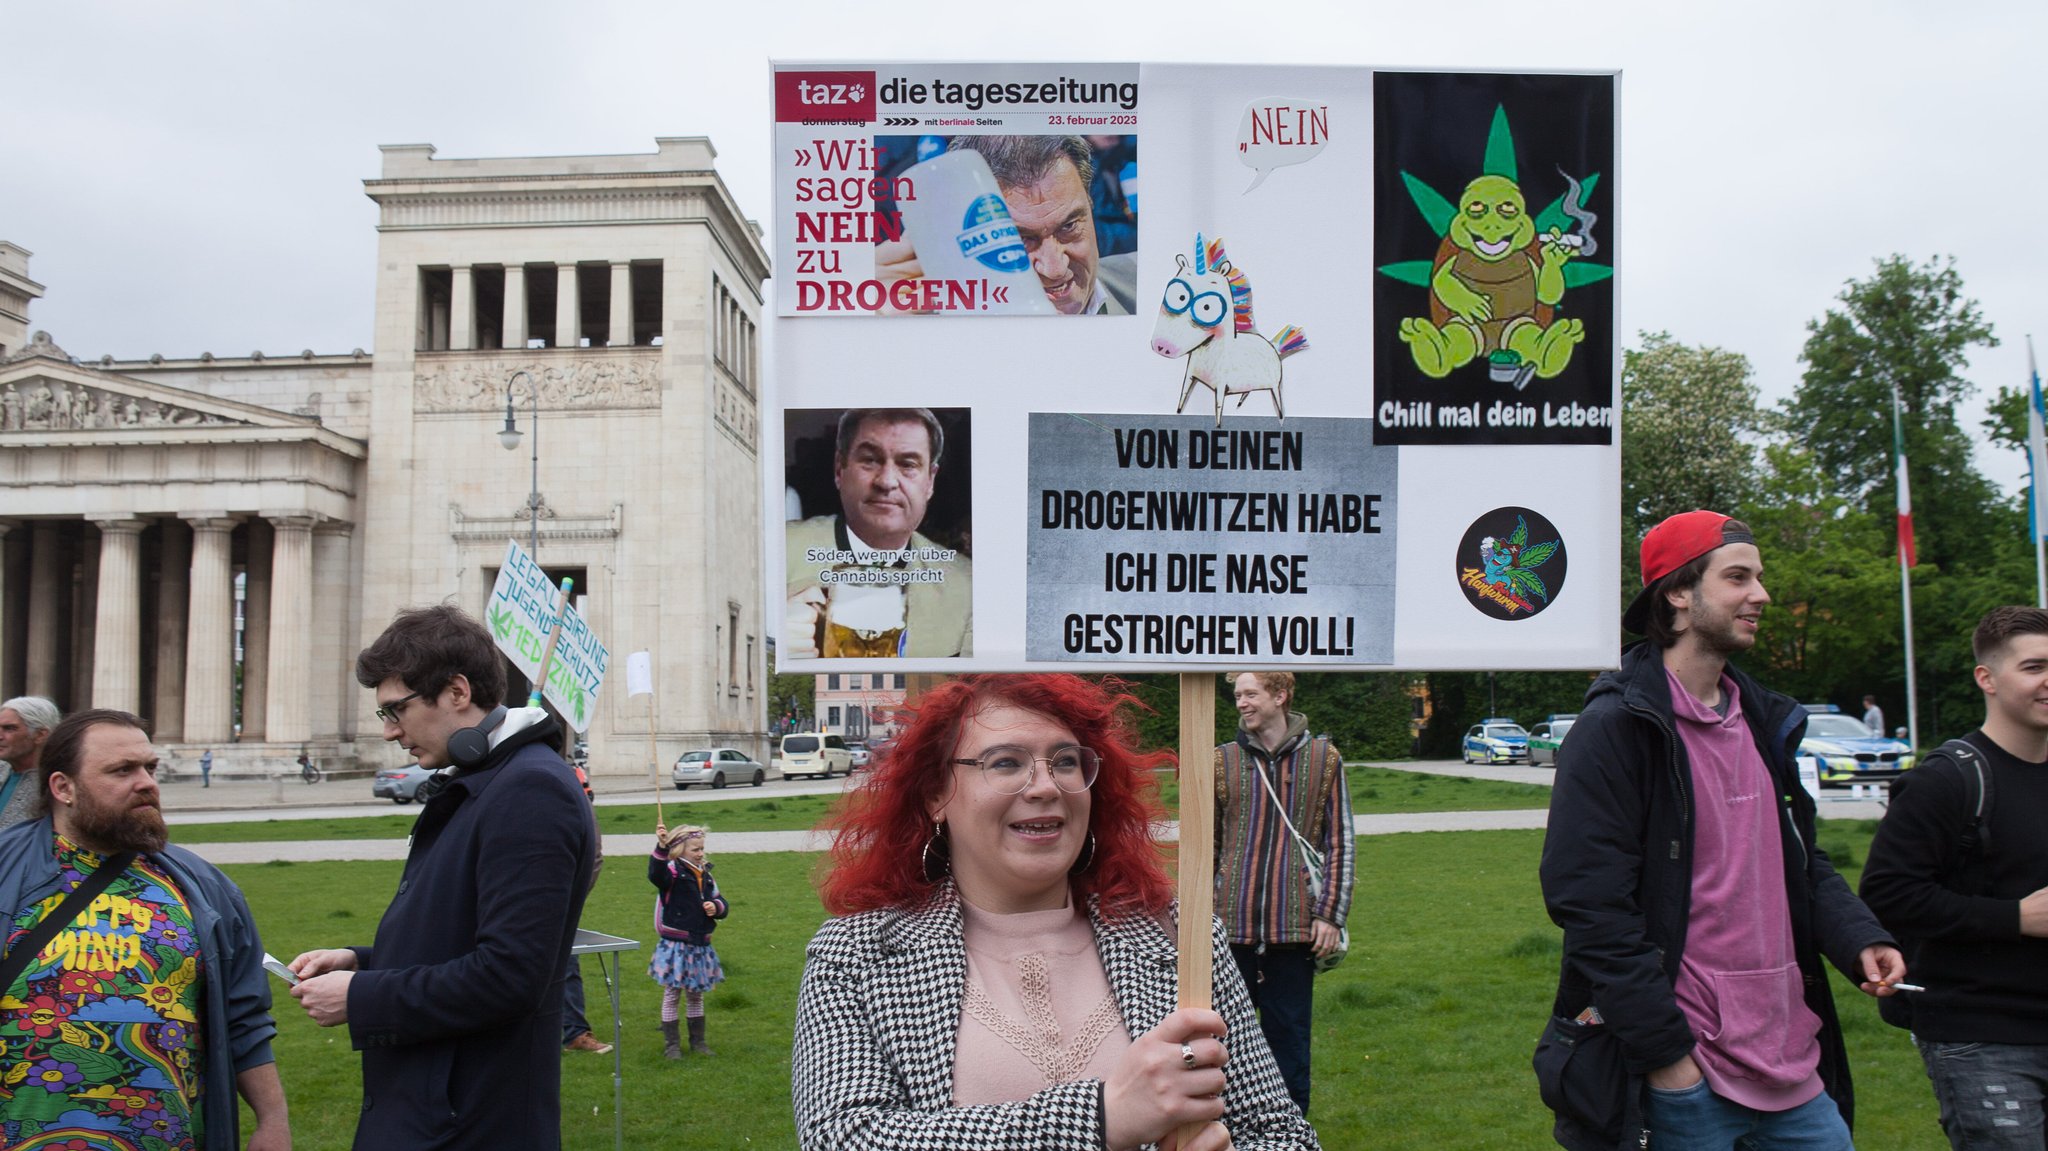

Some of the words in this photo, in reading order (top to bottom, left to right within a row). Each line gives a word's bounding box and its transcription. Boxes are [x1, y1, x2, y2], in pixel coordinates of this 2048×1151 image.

[798, 79, 847, 105] taz
[880, 77, 927, 104] die
[932, 77, 1138, 110] tageszeitung
[802, 116, 866, 128] donnerstag
[924, 118, 939, 126] mit
[939, 118, 975, 126] berlinale
[976, 118, 1003, 126] Seiten
[1048, 115, 1065, 125] 23.
[1067, 115, 1109, 125] februar
[1110, 115, 1137, 125] 2023
[795, 138, 887, 171] »Wir
[796, 175, 916, 209] sagen
[796, 211, 902, 243] NEIN
[961, 233, 988, 251] DAS
[796, 250, 842, 273] zu
[796, 279, 1009, 311] DROGEN!«
[1378, 400, 1432, 428] Chill
[1438, 400, 1480, 428] mal
[1486, 400, 1536, 428] dein
[1543, 401, 1612, 428] Leben
[1114, 428, 1178, 469] VON
[1189, 430, 1302, 471] DEINEN
[1041, 489, 1289, 532] DROGENWITZEN
[1298, 493, 1381, 534] HABE
[807, 549, 854, 562] Söder,
[857, 551, 898, 560] wenn
[902, 550, 917, 560] er
[921, 548, 955, 560] über
[820, 570, 888, 583] Cannabis
[893, 570, 943, 585] spricht
[1105, 552, 1157, 592] ICH
[1167, 553, 1217, 593] DIE
[1226, 553, 1308, 594] NASE
[1064, 613, 1258, 654] GESTRICHEN
[1267, 616, 1355, 656] VOLL!
